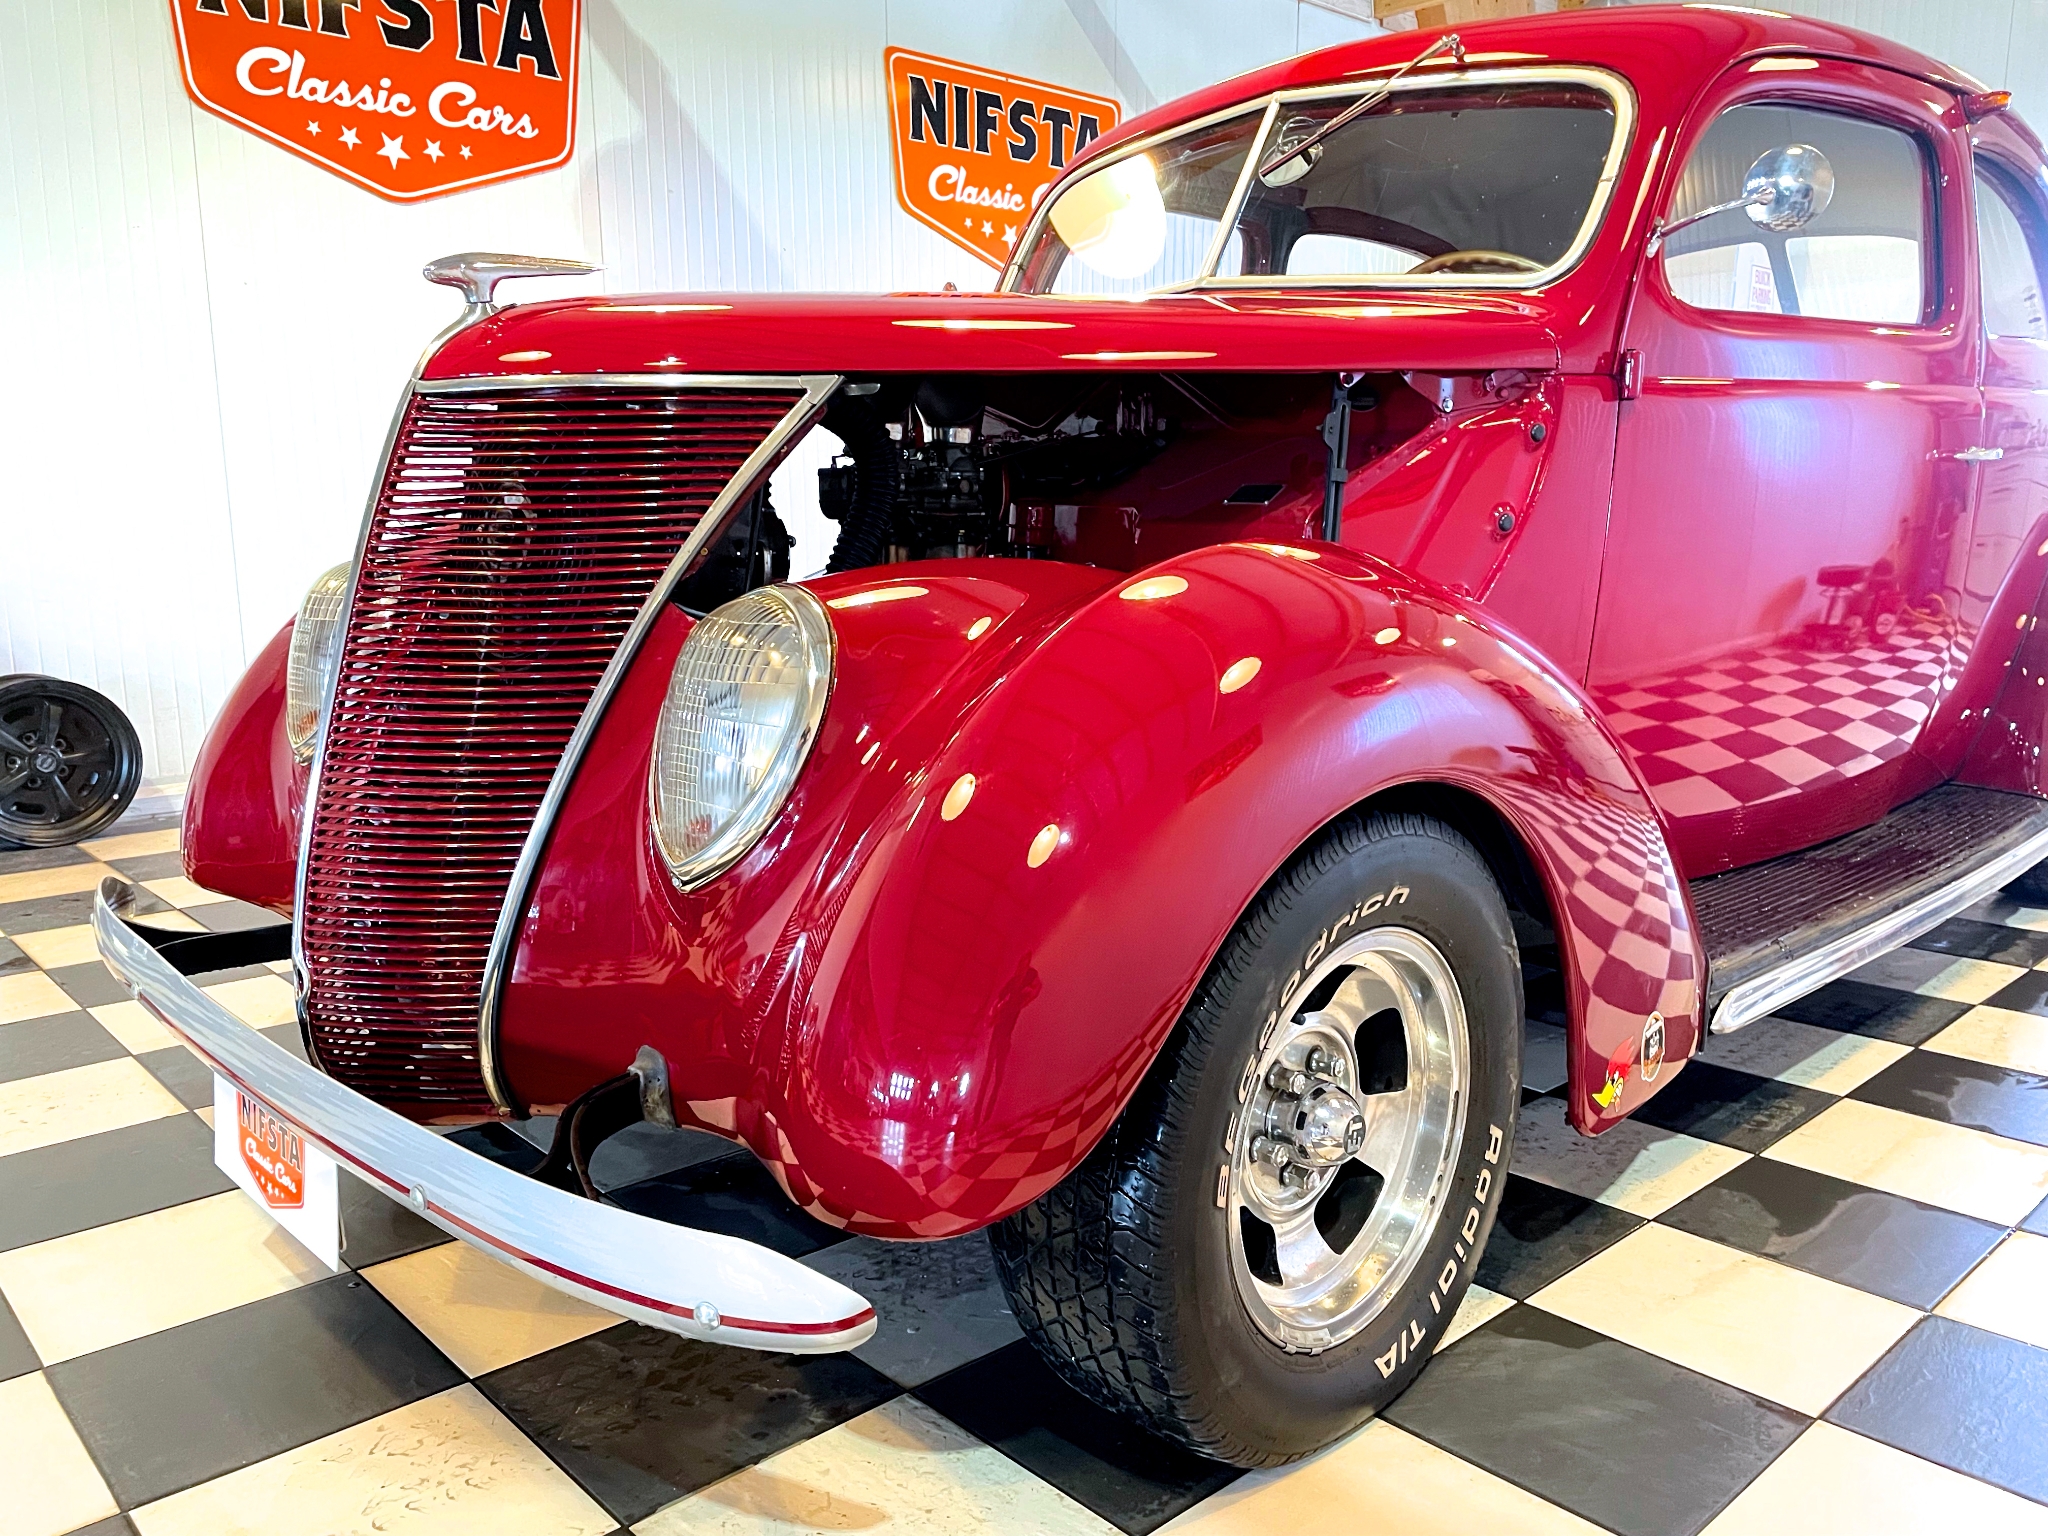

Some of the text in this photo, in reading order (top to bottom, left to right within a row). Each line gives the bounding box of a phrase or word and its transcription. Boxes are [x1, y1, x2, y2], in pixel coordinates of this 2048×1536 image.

[197, 0, 562, 81] STA
[236, 46, 539, 139] Classic Cars
[928, 164, 1026, 212] Classic
[240, 1093, 302, 1173] NIFSTA
[1428, 1124, 1503, 1316] Radial
